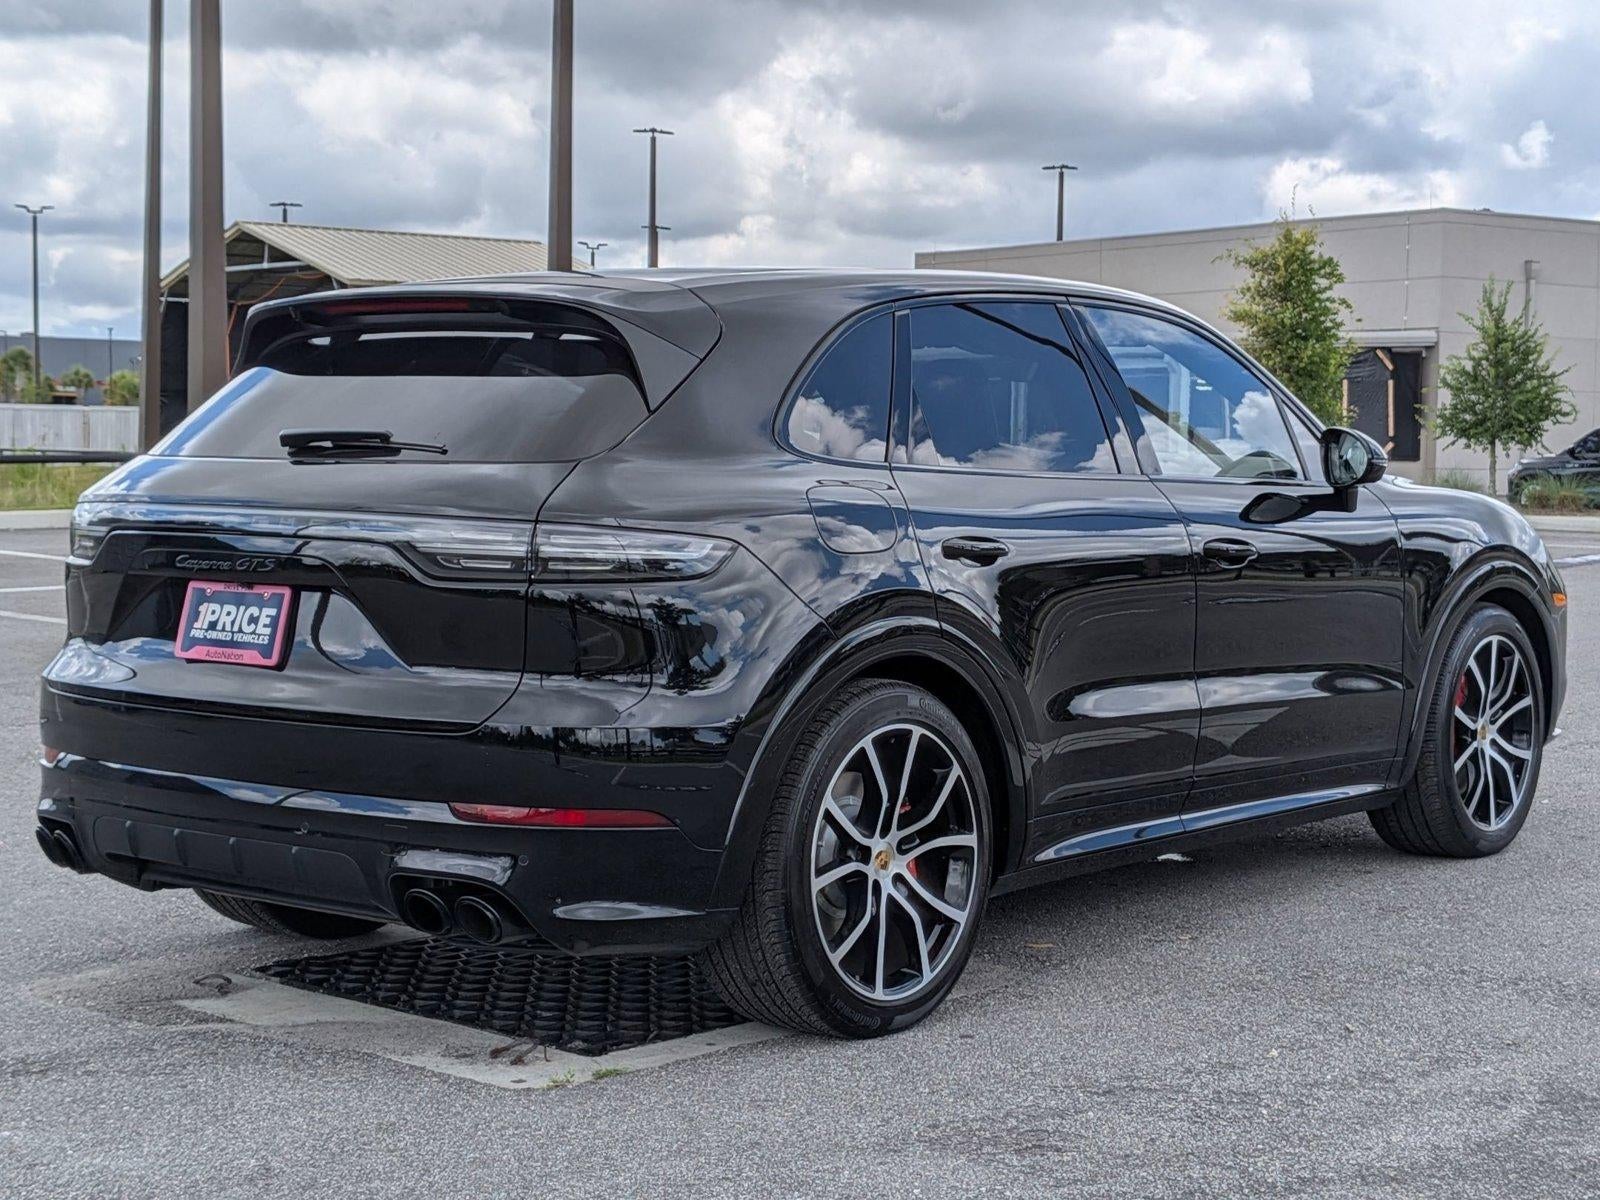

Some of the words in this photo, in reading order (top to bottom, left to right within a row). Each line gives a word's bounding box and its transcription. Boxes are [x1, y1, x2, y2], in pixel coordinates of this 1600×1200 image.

[175, 554, 232, 572] Cayenne
[236, 558, 276, 571] GTS
[190, 628, 232, 640] PRE-OWNED
[233, 633, 270, 645] VEHICLES
[205, 649, 244, 660] AutoNation
